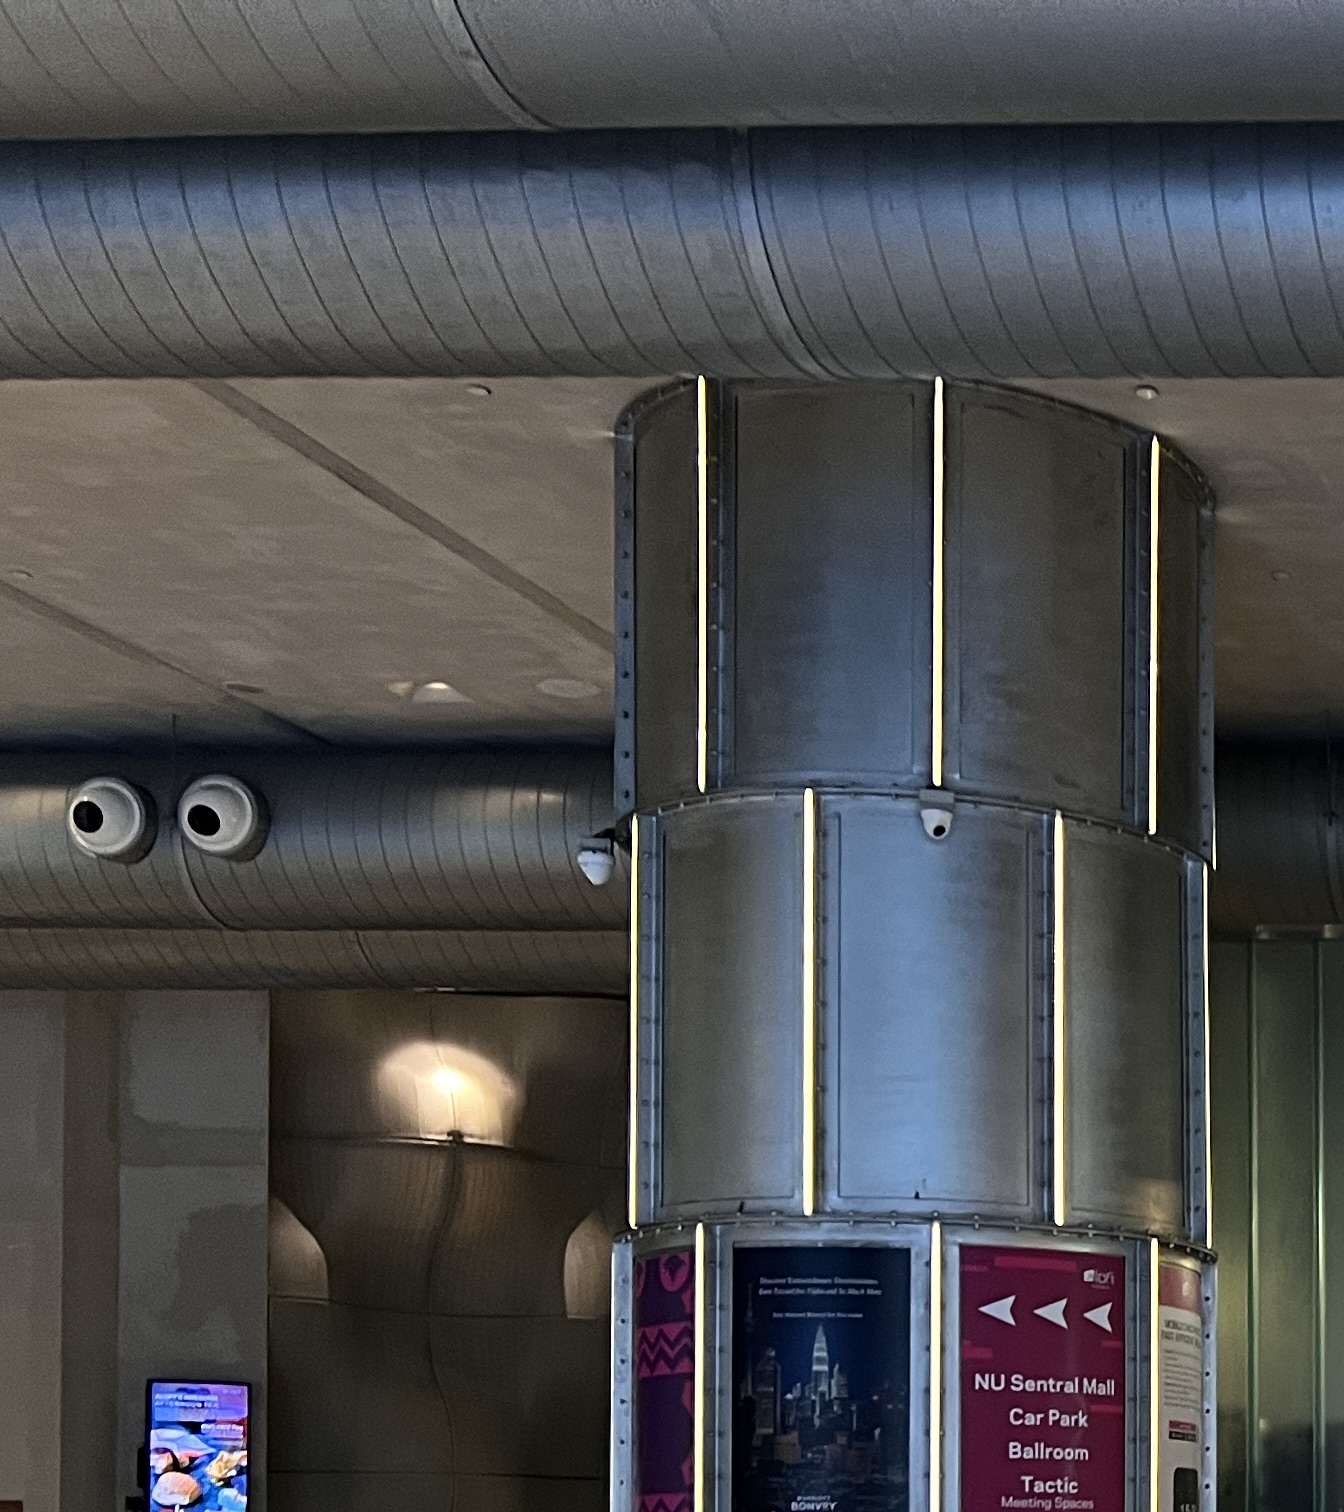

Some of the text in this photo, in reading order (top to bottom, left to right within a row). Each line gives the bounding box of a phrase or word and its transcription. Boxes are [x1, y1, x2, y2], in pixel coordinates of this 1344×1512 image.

[974, 1373, 1115, 1396] NU Sentral Mall
[1009, 1408, 1089, 1427] Car Park
[1008, 1441, 1089, 1461] Ballroom
[1020, 1475, 1079, 1494] Tactic
[1001, 1495, 1094, 1511] Meeting Spaces
